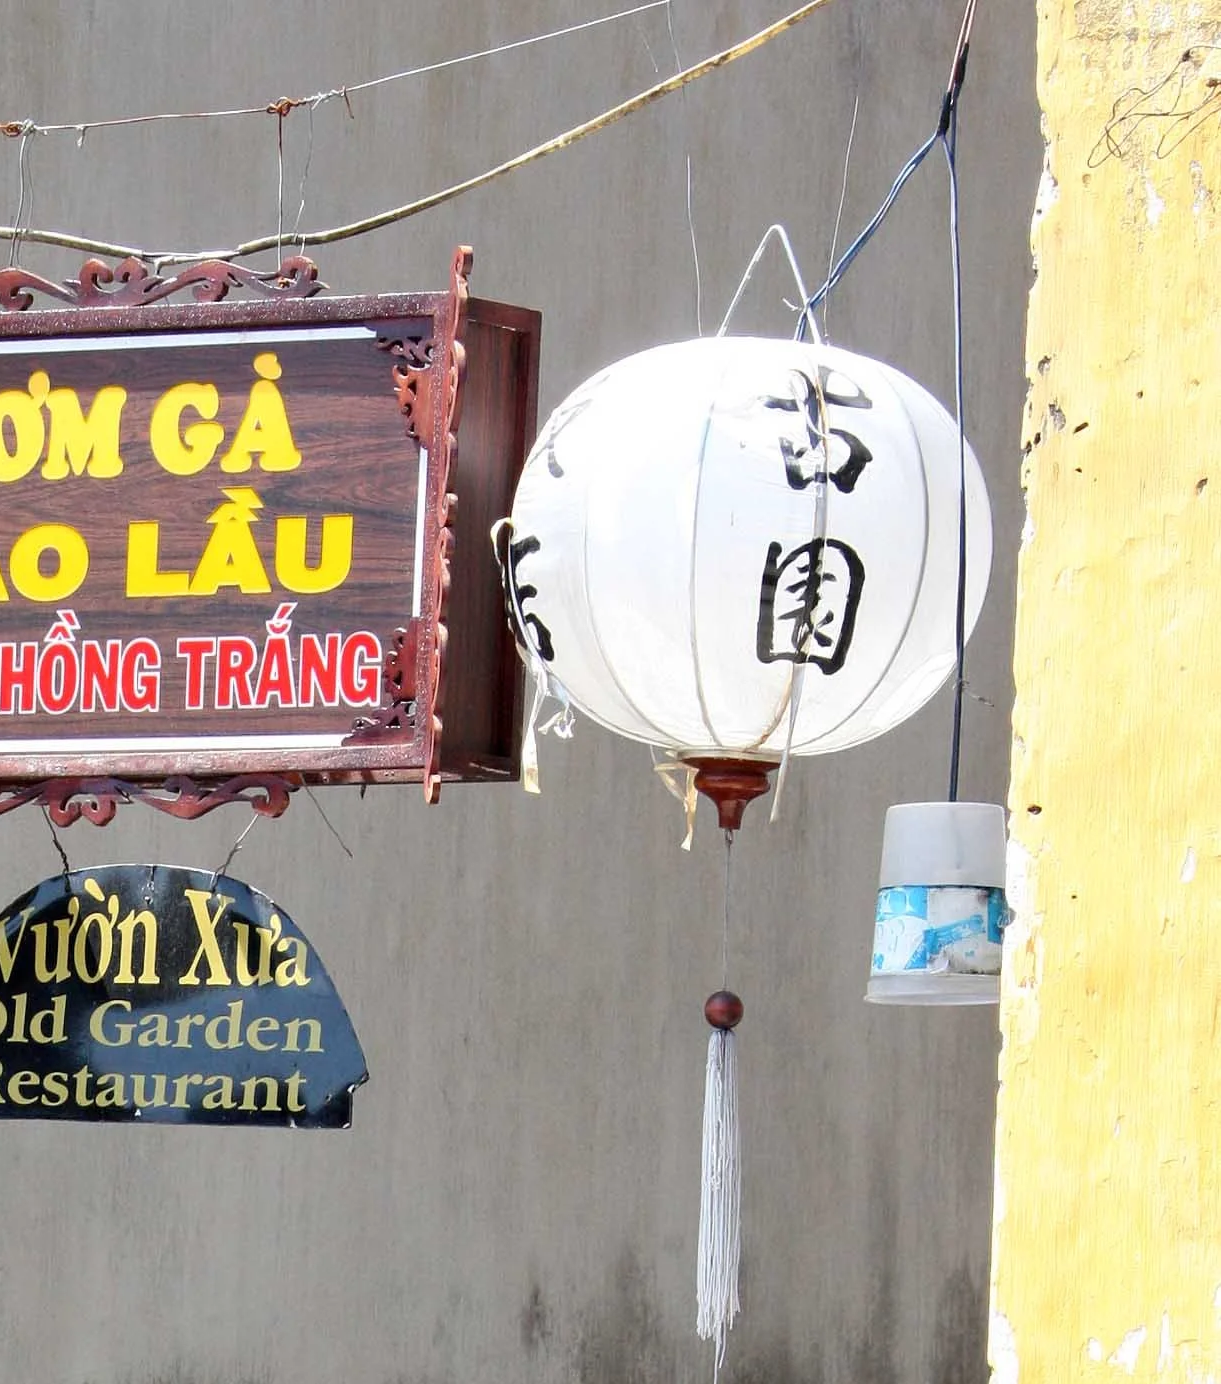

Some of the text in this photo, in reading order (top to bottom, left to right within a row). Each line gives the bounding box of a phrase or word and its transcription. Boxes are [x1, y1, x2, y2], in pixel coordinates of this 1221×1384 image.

[149, 352, 302, 476] GÀ
[126, 487, 354, 598] LẦU
[177, 602, 382, 710] TRẮNG
[178, 888, 311, 987] Xưa
[89, 999, 325, 1053] Garden
